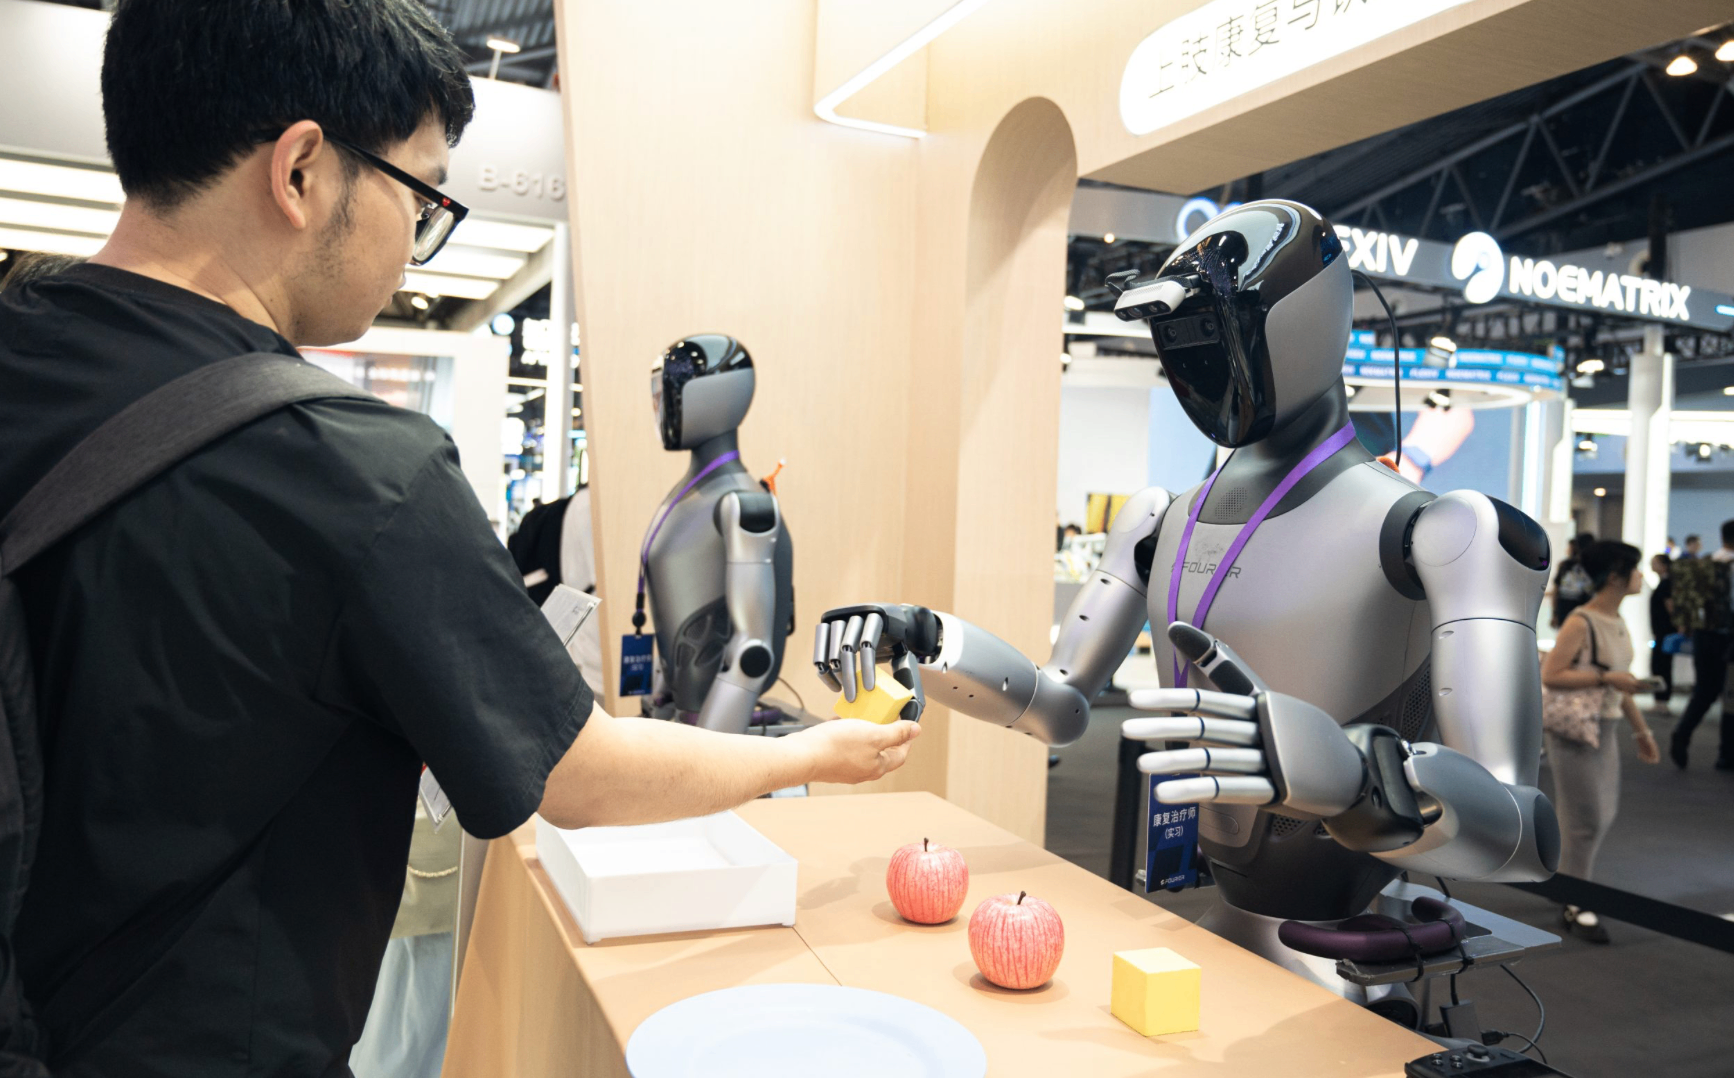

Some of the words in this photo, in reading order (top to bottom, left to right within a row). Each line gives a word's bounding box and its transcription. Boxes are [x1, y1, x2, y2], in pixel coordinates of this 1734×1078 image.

[1148, 0, 1369, 99] 上肢康复与
[1509, 255, 1692, 321] NOEMATRIX
[1182, 562, 1242, 579] FOURR
[1153, 806, 1197, 828] 康复治疗师
[1164, 825, 1184, 840] (实习)
